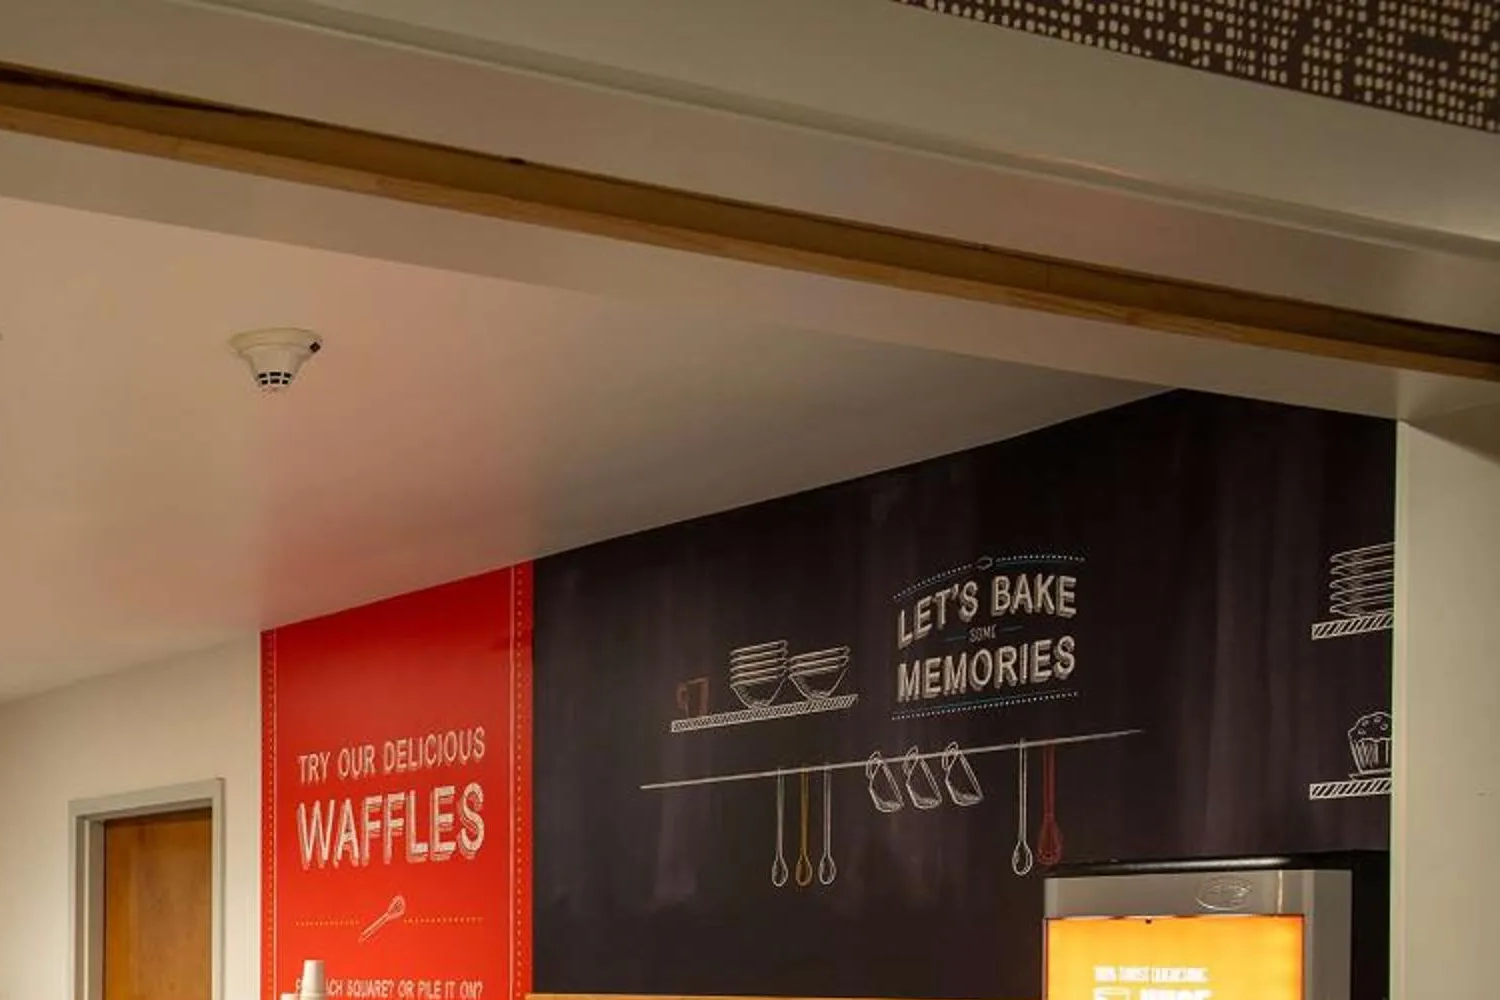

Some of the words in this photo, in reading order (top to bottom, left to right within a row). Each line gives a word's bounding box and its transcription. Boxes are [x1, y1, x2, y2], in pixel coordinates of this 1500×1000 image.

[897, 581, 978, 649] LET'S
[991, 573, 1077, 618] BAKE
[969, 624, 997, 643] SOME
[897, 635, 1075, 702] MEMORIES
[297, 752, 330, 784] TRY
[338, 744, 375, 780] OUR
[383, 726, 486, 774] DELICIOUS
[297, 782, 485, 871] WAFFLES
[347, 979, 394, 1000] SQUARE?
[398, 979, 414, 1000] OR
[417, 980, 441, 1000] PILE
[445, 981, 456, 1000] IT
